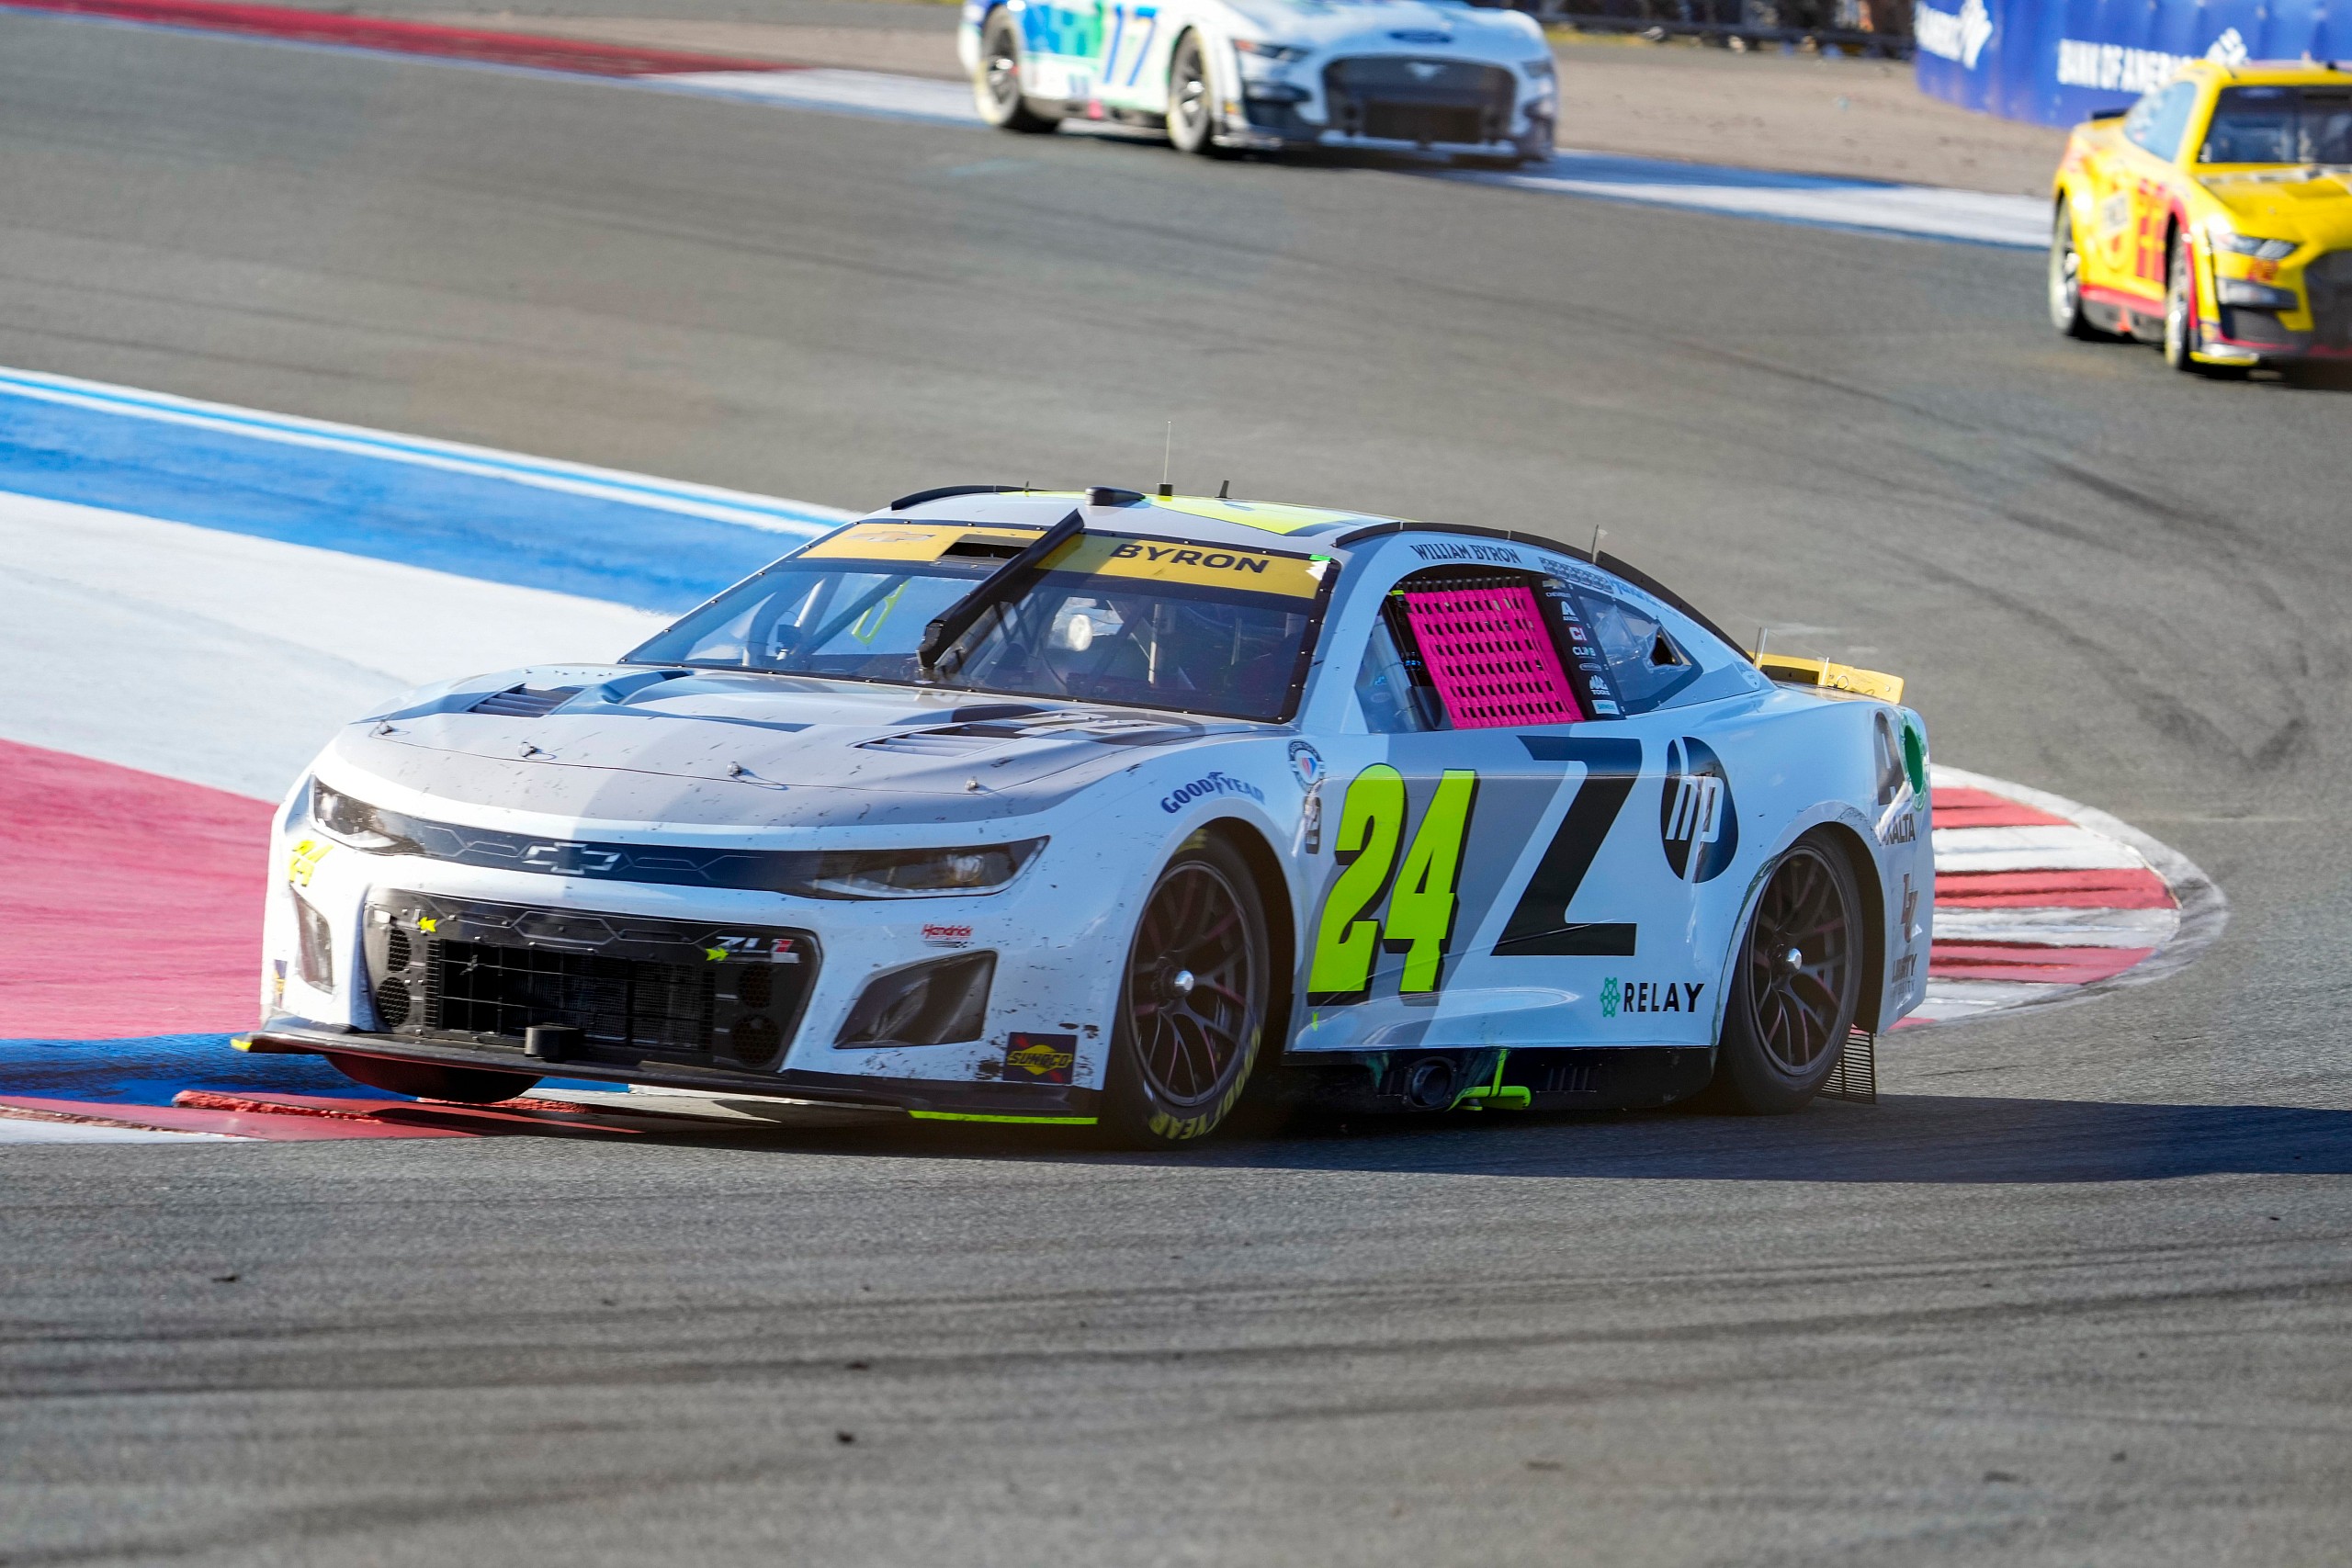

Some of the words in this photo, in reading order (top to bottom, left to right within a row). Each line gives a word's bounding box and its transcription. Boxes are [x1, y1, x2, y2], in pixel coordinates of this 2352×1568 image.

[1102, 3, 1159, 87] 17
[1110, 543, 1270, 574] BYRON
[1408, 543, 1472, 560] WILLIAM
[1469, 544, 1522, 564] BYRON
[1160, 771, 1266, 815] GOODYEAR
[1879, 812, 1917, 847] XALTA
[1490, 735, 1643, 956] Z
[1307, 762, 1481, 1006] 24
[716, 935, 795, 954] ZL1
[921, 923, 973, 941] Hendrick
[1622, 982, 1705, 1013] RELAY
[1009, 1052, 1070, 1067] SUNOCO
